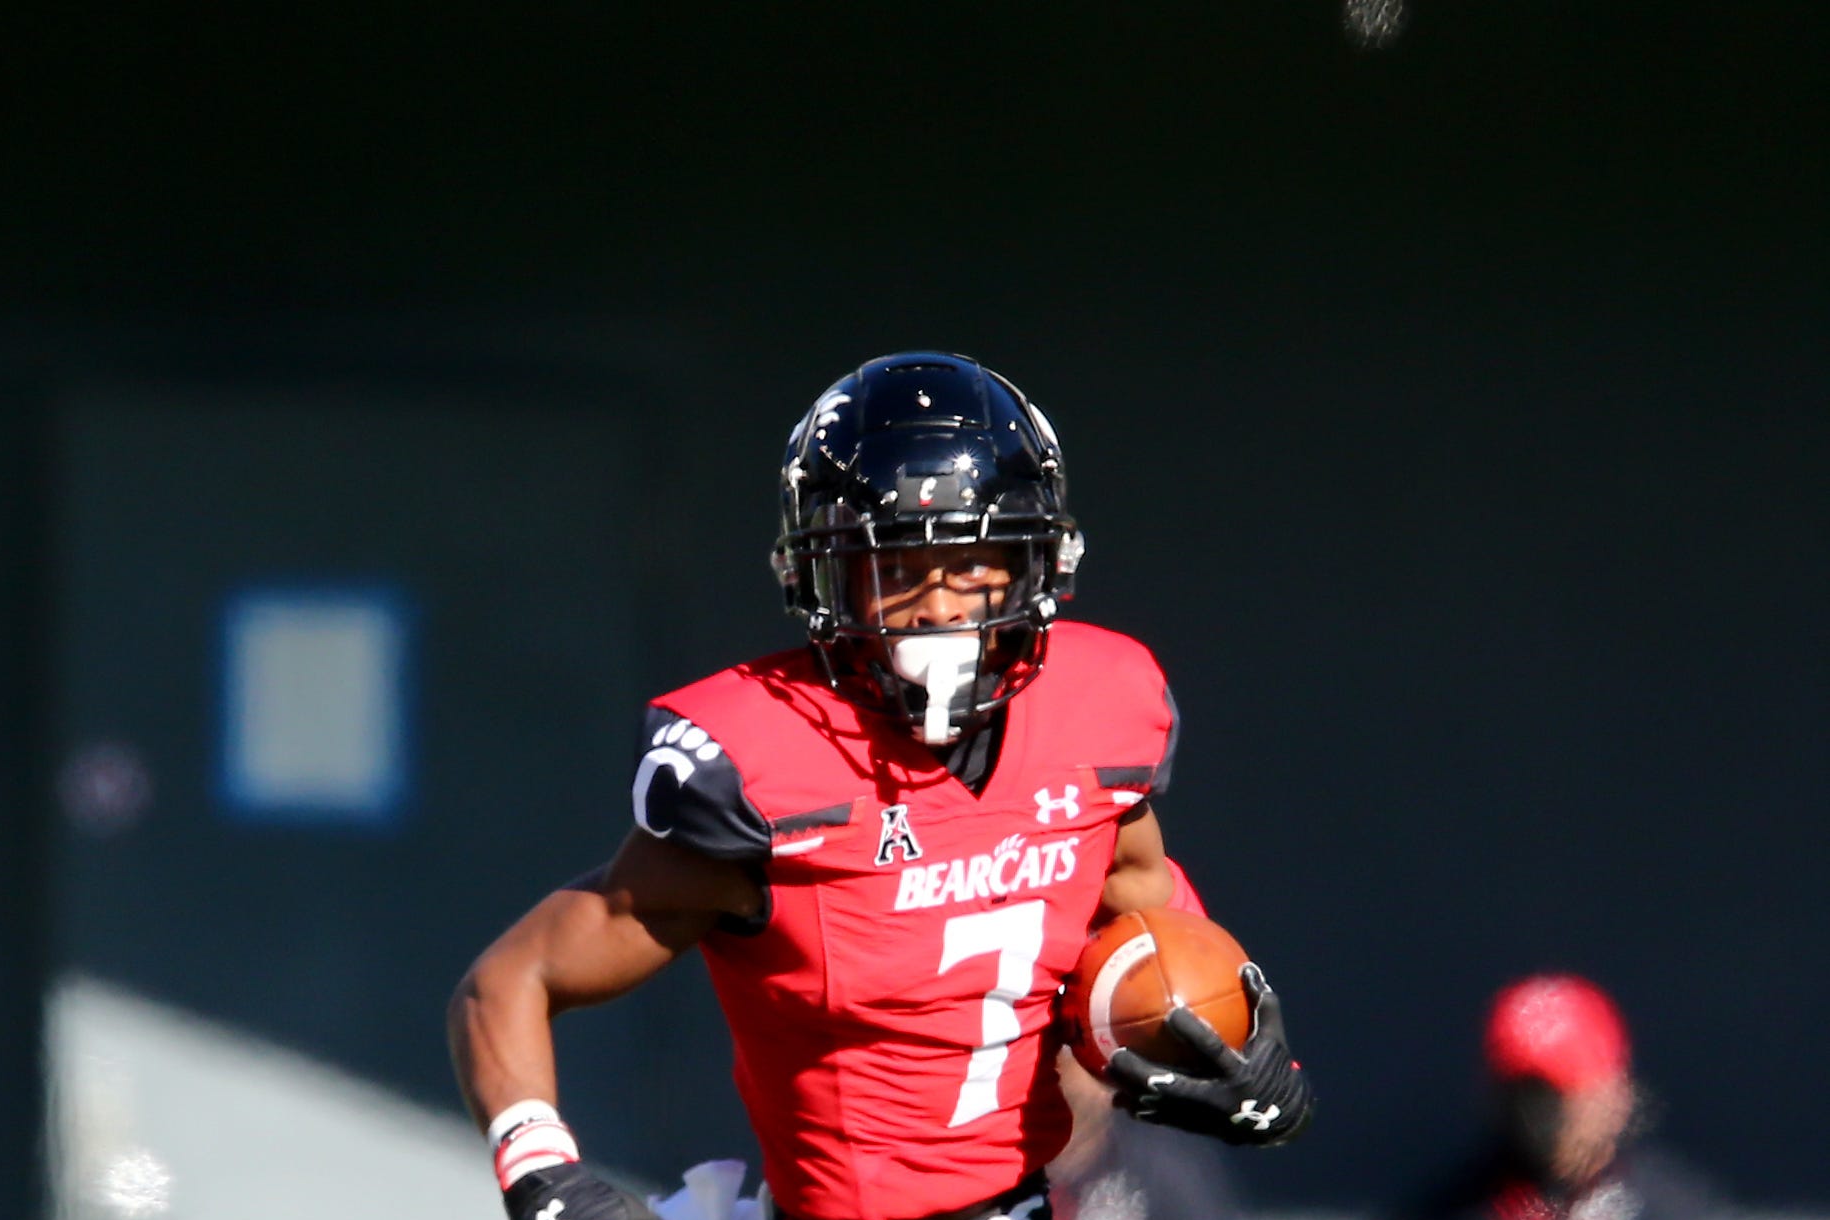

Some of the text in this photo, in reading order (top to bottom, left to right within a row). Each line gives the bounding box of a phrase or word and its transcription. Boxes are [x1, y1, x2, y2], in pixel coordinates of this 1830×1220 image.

[874, 803, 923, 866] A
[894, 836, 1079, 911] BEARCATS
[938, 899, 1046, 1128] 7
